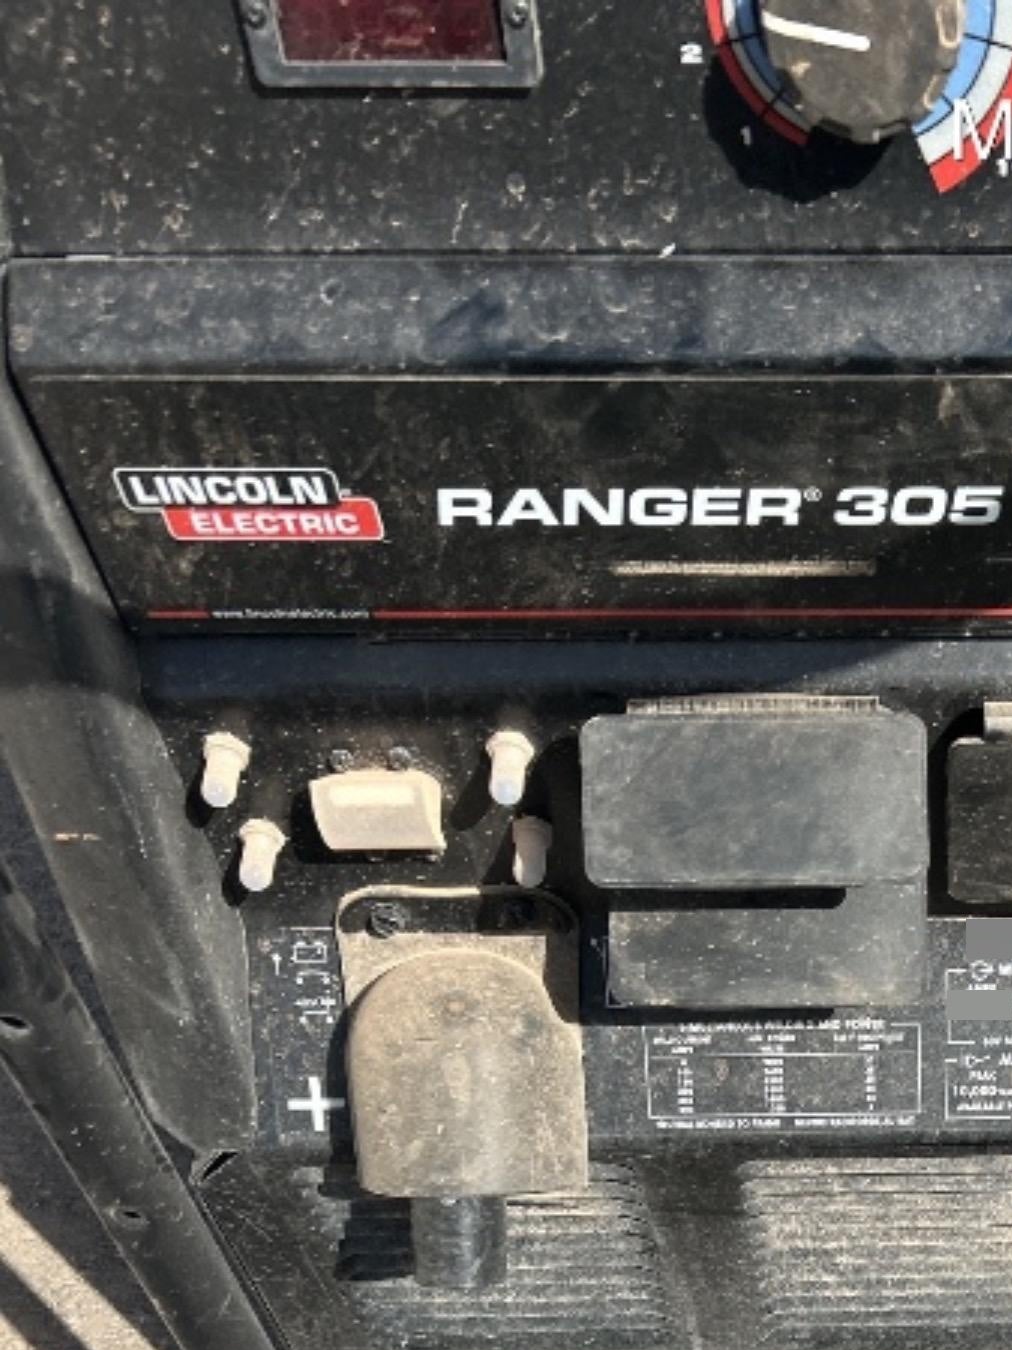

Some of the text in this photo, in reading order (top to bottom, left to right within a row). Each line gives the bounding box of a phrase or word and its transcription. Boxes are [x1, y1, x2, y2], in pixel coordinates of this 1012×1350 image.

[680, 44, 704, 65] 2
[127, 475, 329, 506] LINCOLN
[832, 485, 1004, 527] 305
[191, 510, 361, 536] ELECTRIC
